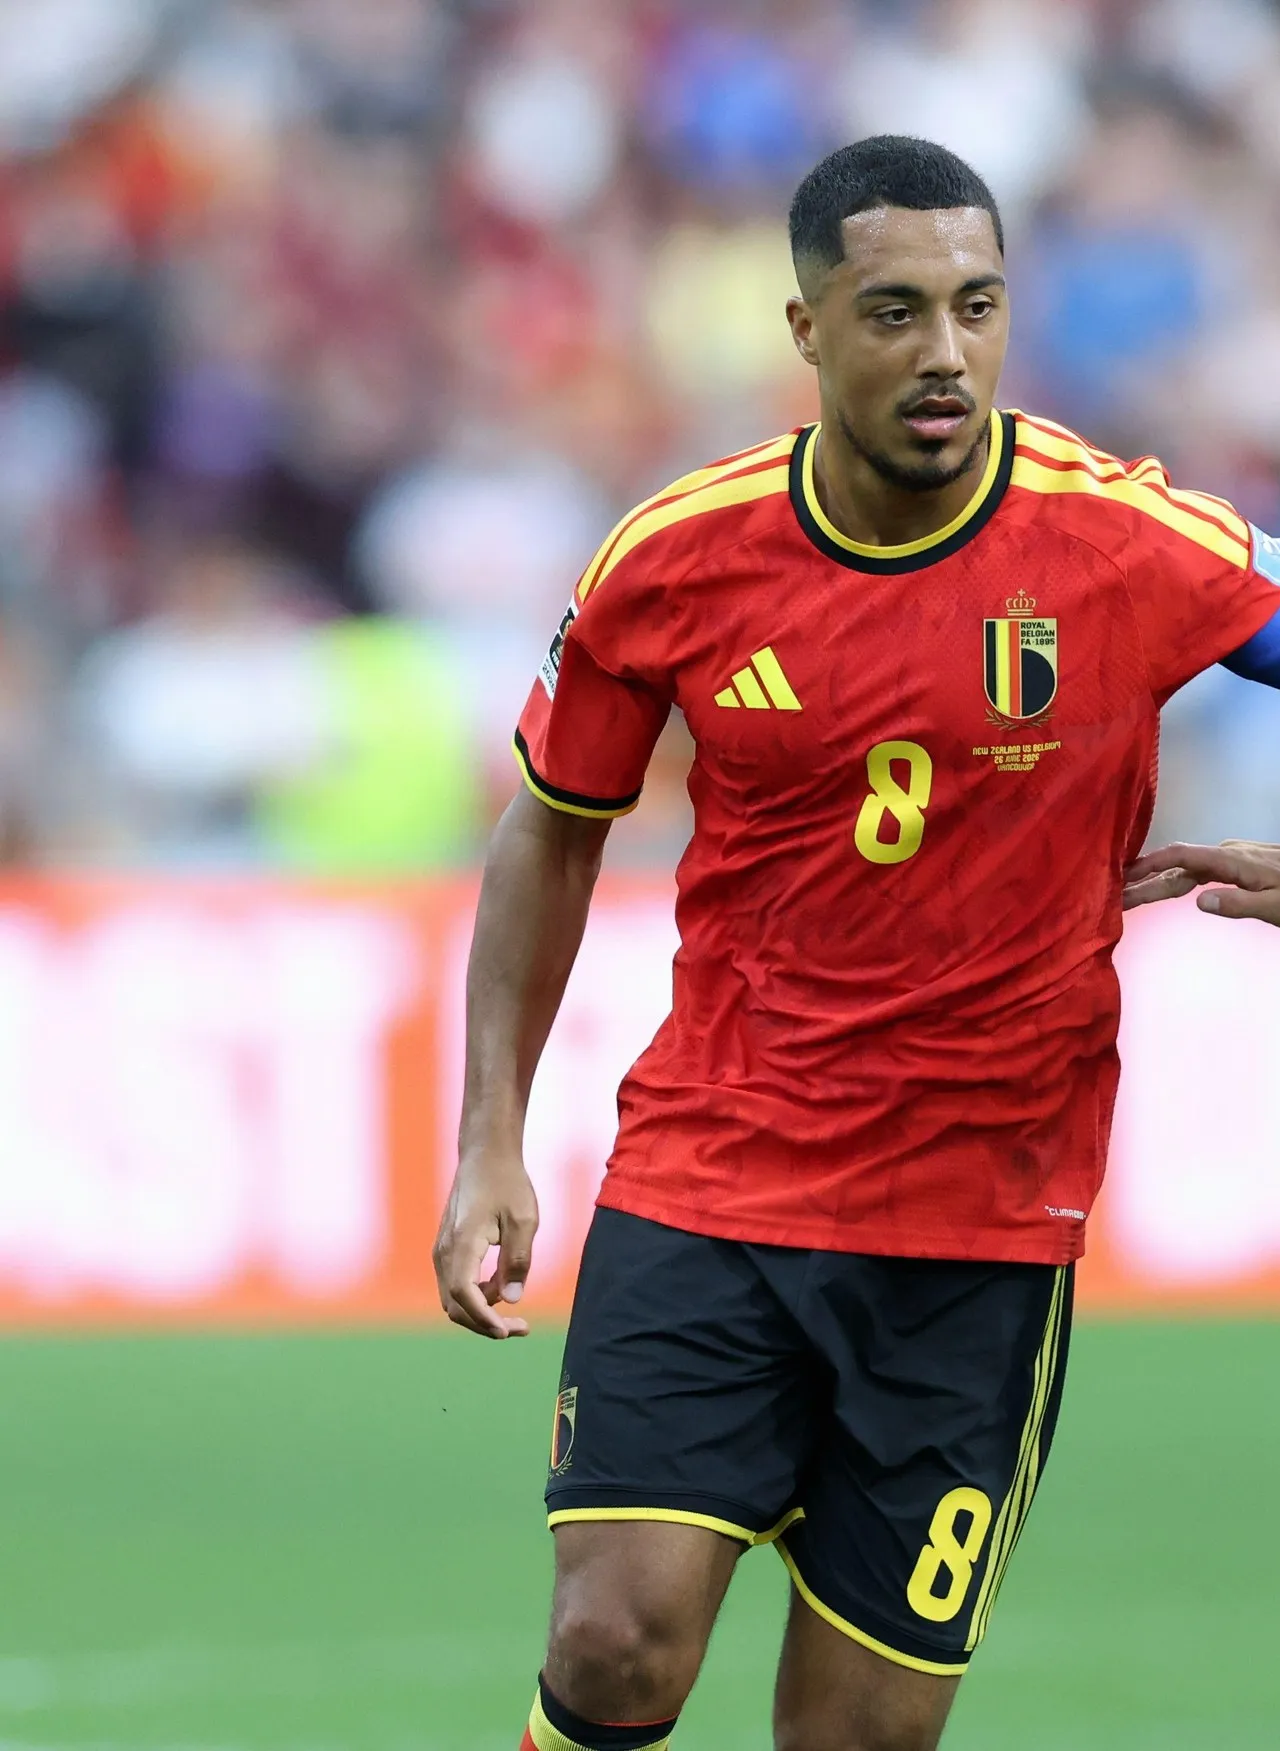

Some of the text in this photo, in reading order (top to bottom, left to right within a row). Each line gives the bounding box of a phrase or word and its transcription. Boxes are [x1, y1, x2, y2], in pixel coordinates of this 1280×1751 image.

[1020, 621, 1046, 629] ROYAL
[1020, 629, 1055, 637] BELGIAN
[854, 740, 932, 865] 8
[906, 1486, 993, 1623] 8
